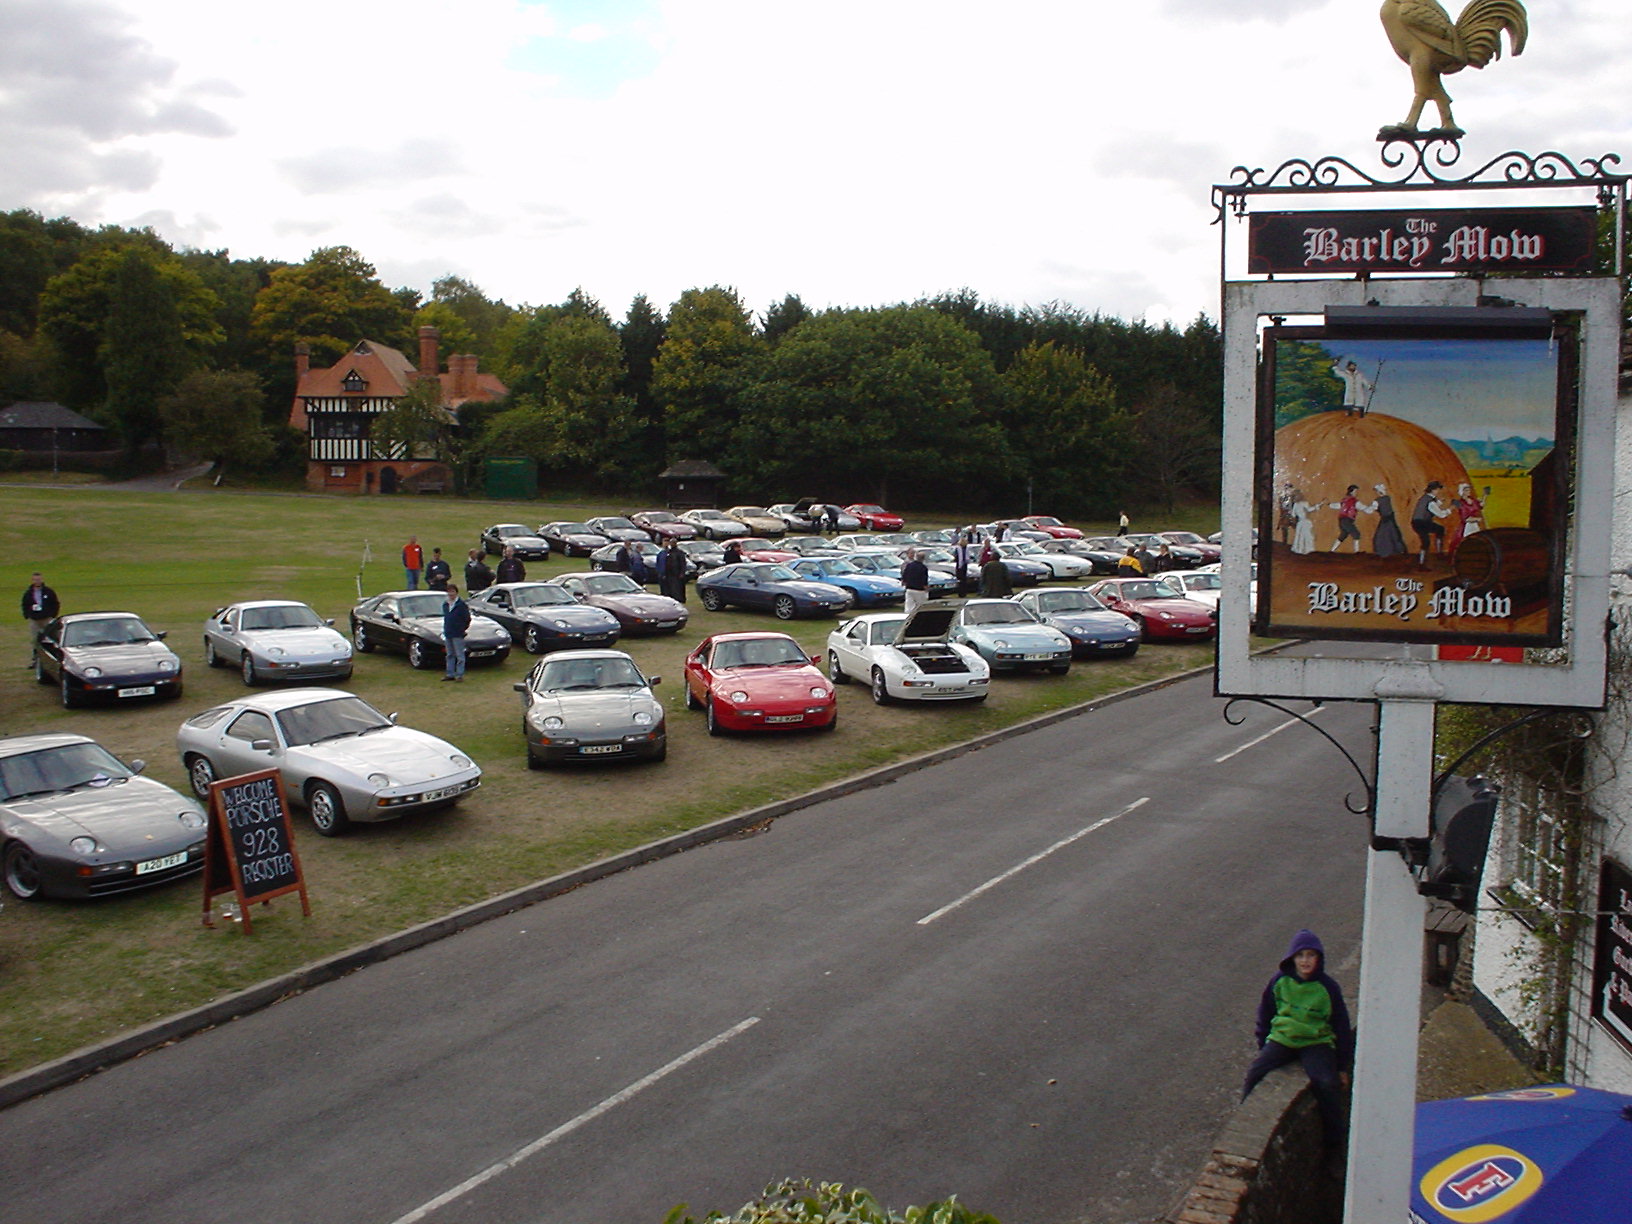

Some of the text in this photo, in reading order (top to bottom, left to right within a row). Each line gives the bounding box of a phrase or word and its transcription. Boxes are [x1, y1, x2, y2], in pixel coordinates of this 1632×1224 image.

[1405, 218, 1438, 235] The
[1303, 225, 1544, 267] Barley Mow
[1395, 578, 1424, 592] The
[1307, 582, 1513, 621] Barley Mow
[222, 779, 276, 806] WELCOME
[226, 797, 283, 829] PORSCHE
[242, 827, 279, 857] 928
